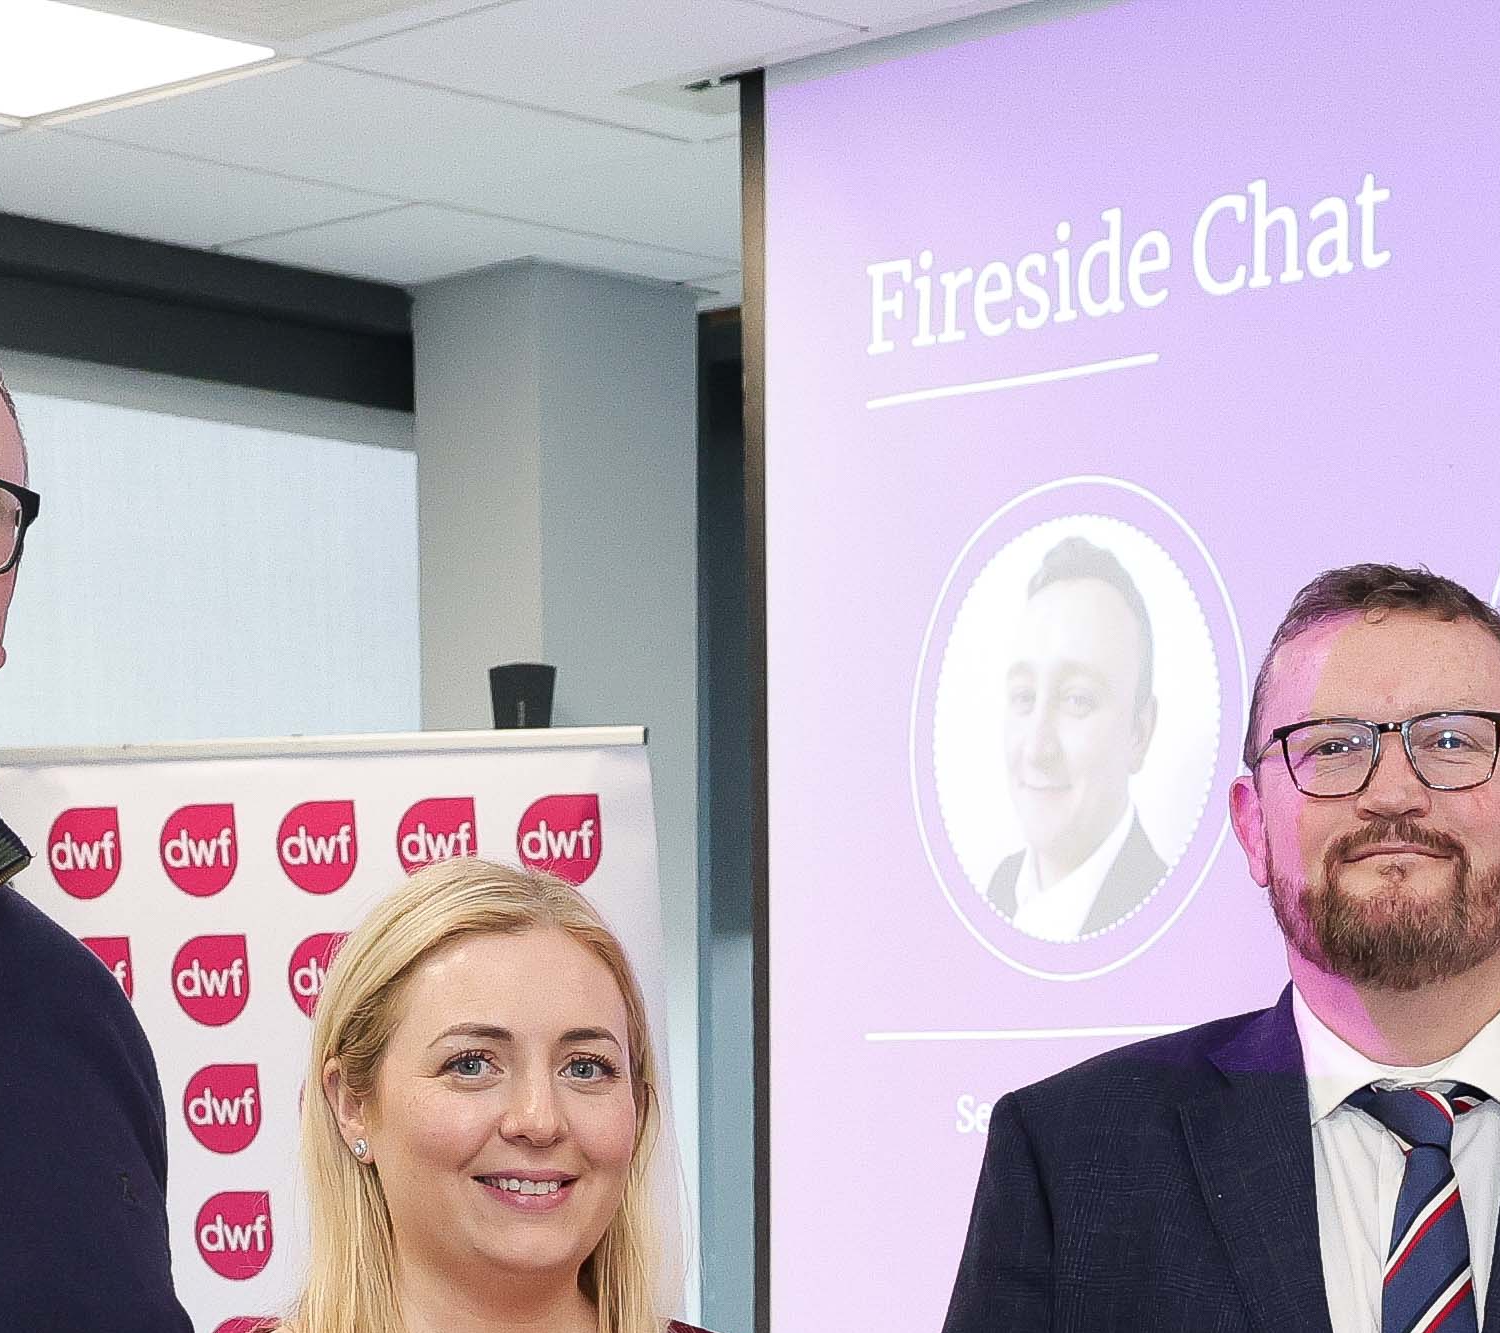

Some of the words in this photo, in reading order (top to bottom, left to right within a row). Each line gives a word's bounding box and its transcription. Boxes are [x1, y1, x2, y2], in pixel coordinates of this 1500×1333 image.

[865, 206, 1172, 356] Fireside
[1192, 172, 1393, 297] Chat
[50, 830, 116, 871] dwf
[164, 827, 233, 869] dwf
[280, 824, 352, 866] dwf
[401, 822, 472, 861] dwf
[521, 818, 595, 861] dwf
[176, 958, 244, 998] dwf
[187, 1087, 256, 1126] dwf
[198, 1214, 268, 1253] dwf
